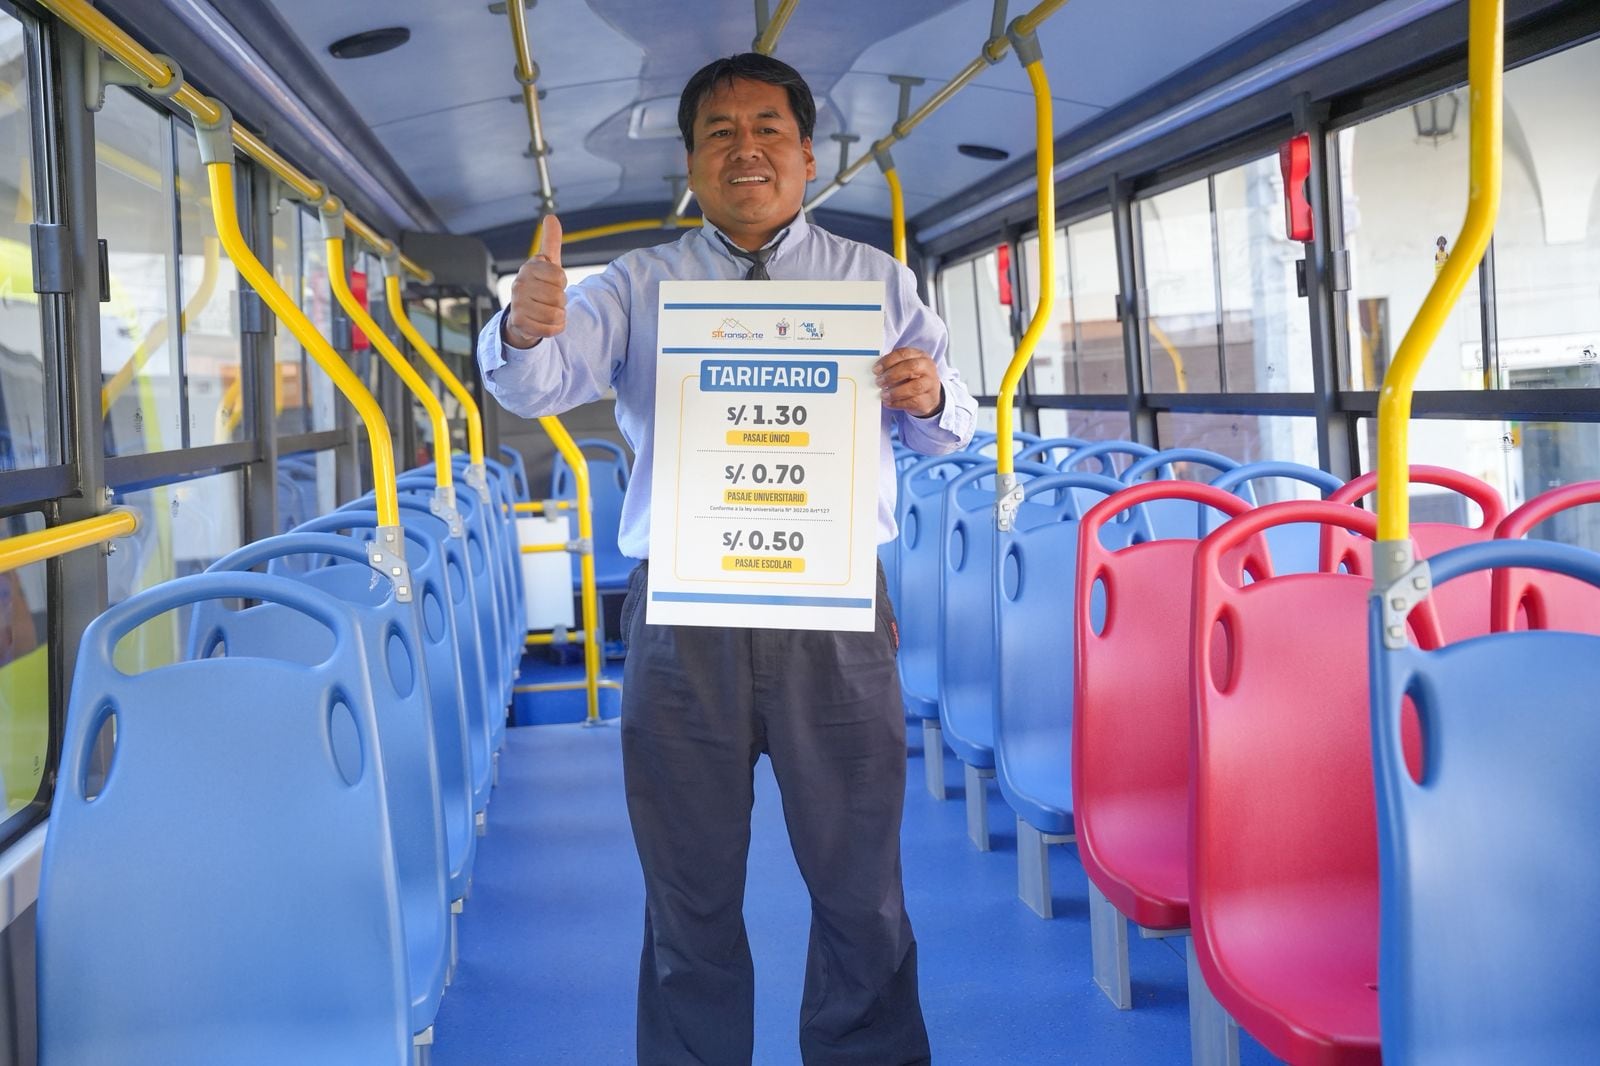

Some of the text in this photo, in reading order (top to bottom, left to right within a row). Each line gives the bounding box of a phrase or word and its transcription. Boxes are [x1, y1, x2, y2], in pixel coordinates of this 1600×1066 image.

[707, 366, 830, 388] TARIFARIO
[753, 405, 807, 425] 1.30
[743, 432, 790, 443] PASAJE ÚNICO
[752, 463, 805, 484] 0.70
[727, 491, 805, 503] PASAJE UNIVERSITARIO
[748, 530, 804, 551] 0.50
[735, 558, 792, 569] PASAJE ESCOLAR
